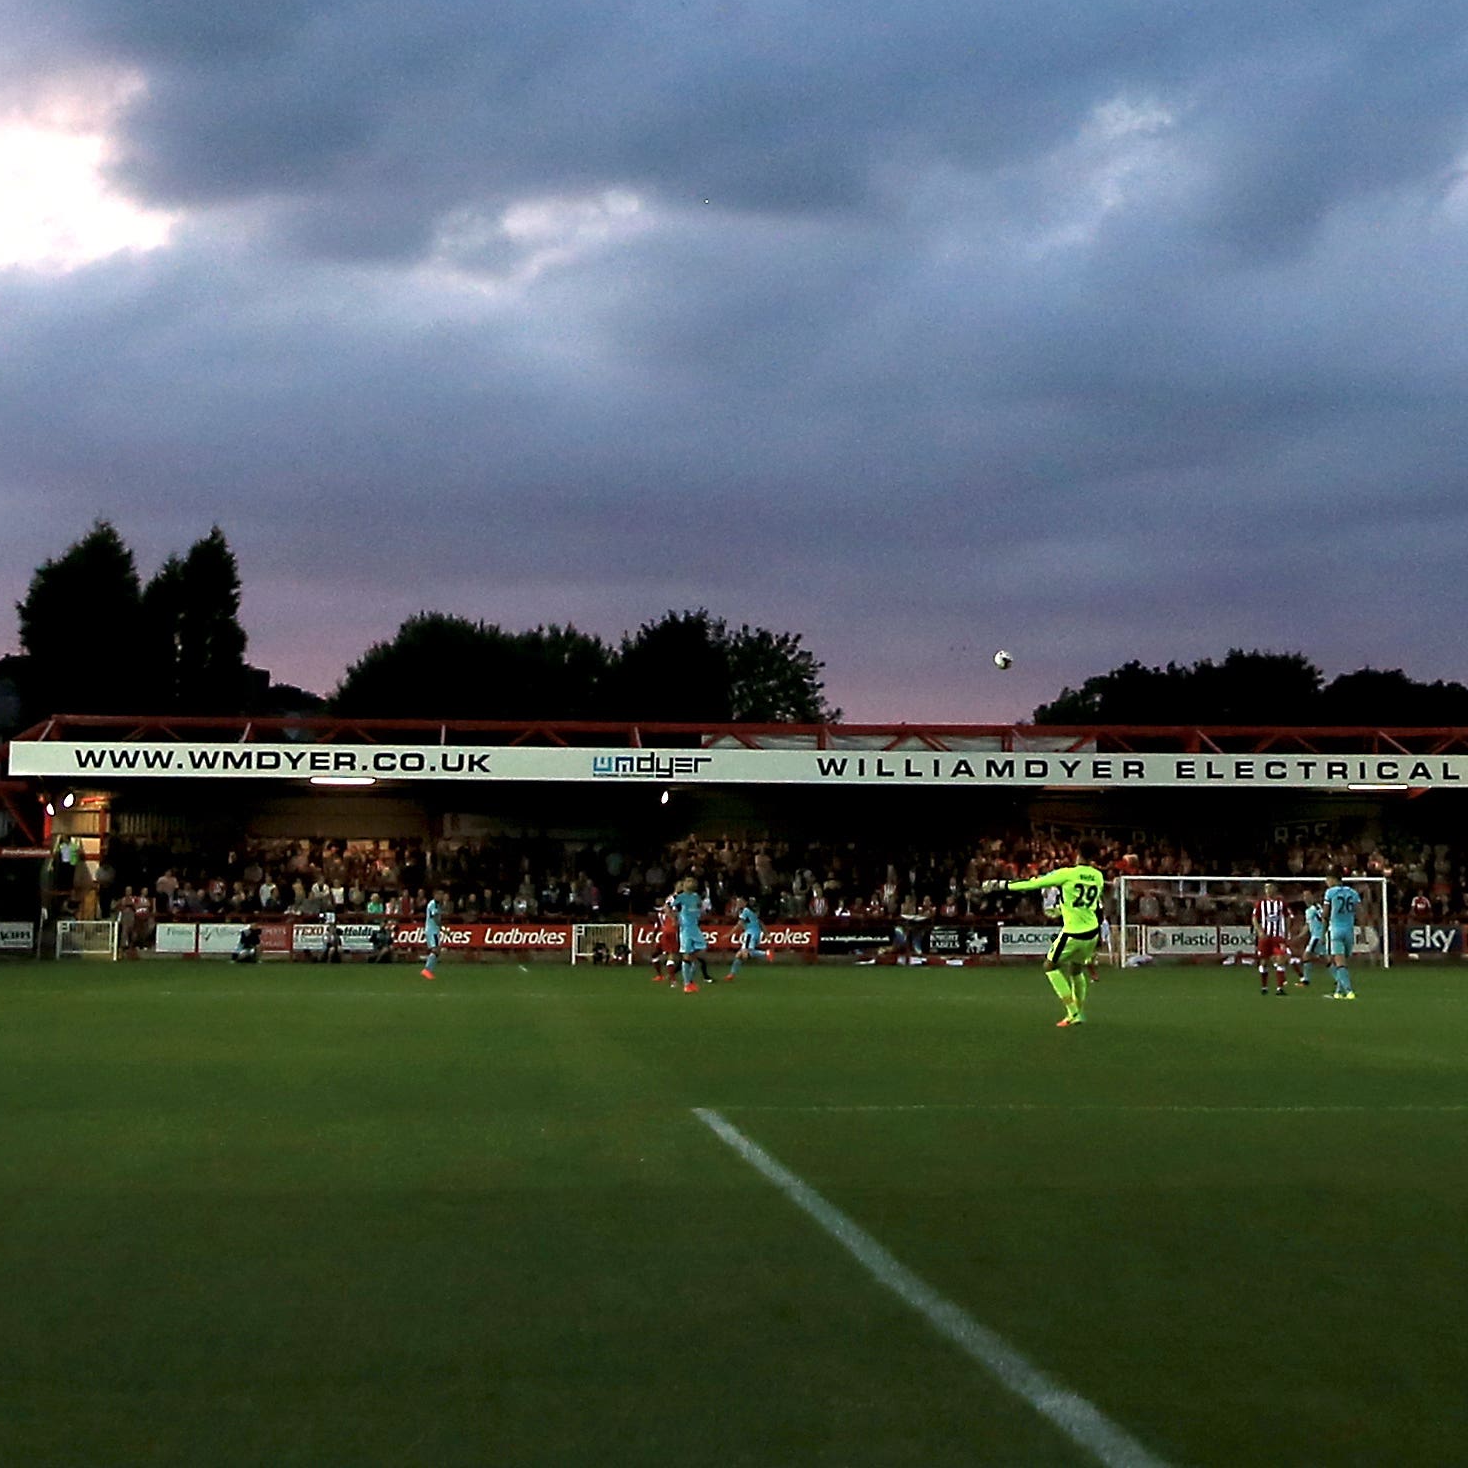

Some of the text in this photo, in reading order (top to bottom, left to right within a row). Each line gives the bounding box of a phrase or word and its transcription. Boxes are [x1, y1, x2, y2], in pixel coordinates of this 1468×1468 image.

[74, 749, 491, 773] WWW.WMDYER.CO.UK
[817, 757, 1145, 780] WILLIAMDYER
[1175, 760, 1460, 781] ELECTRICAL
[1073, 883, 1098, 908] 29
[1337, 896, 1353, 913] 26
[393, 927, 473, 945] Ladbkes
[484, 927, 567, 945] Ladbrokes
[1172, 933, 1216, 946] Plastic
